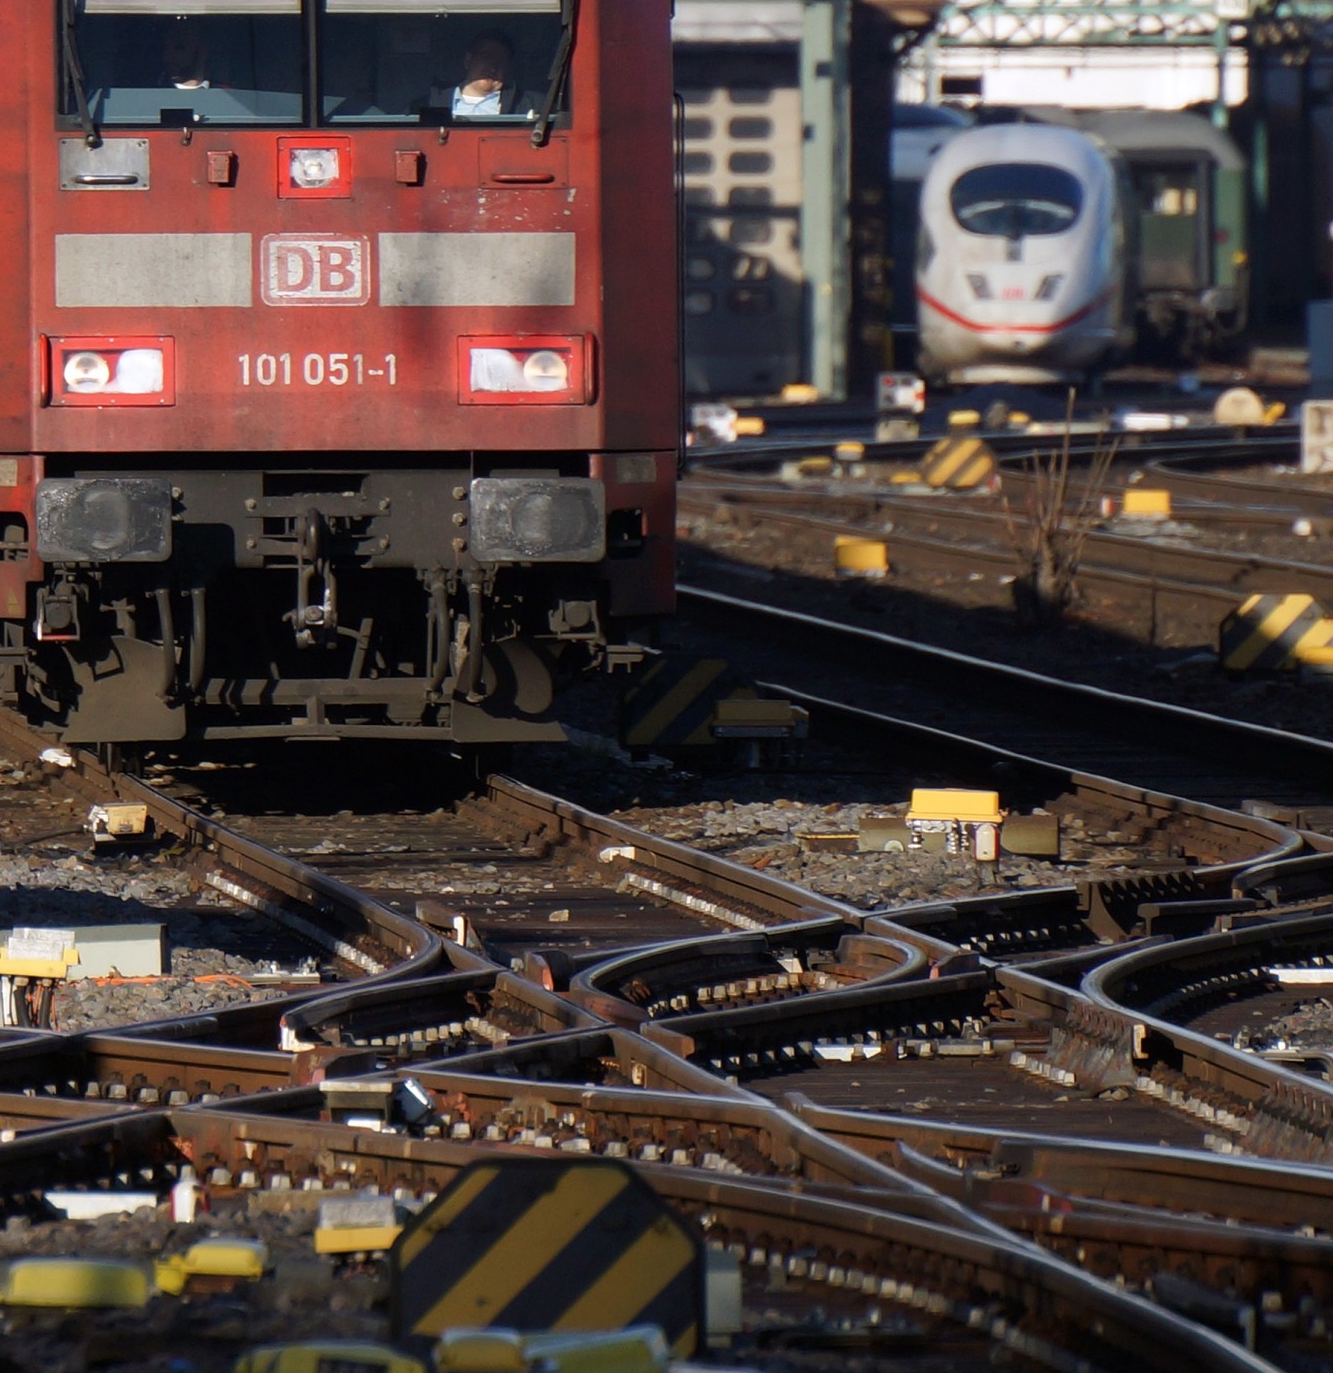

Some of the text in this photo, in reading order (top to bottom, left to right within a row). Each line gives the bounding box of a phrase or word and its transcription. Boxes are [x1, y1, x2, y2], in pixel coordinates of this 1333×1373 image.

[276, 246, 356, 293] DB
[238, 352, 397, 386] 101 051-1
